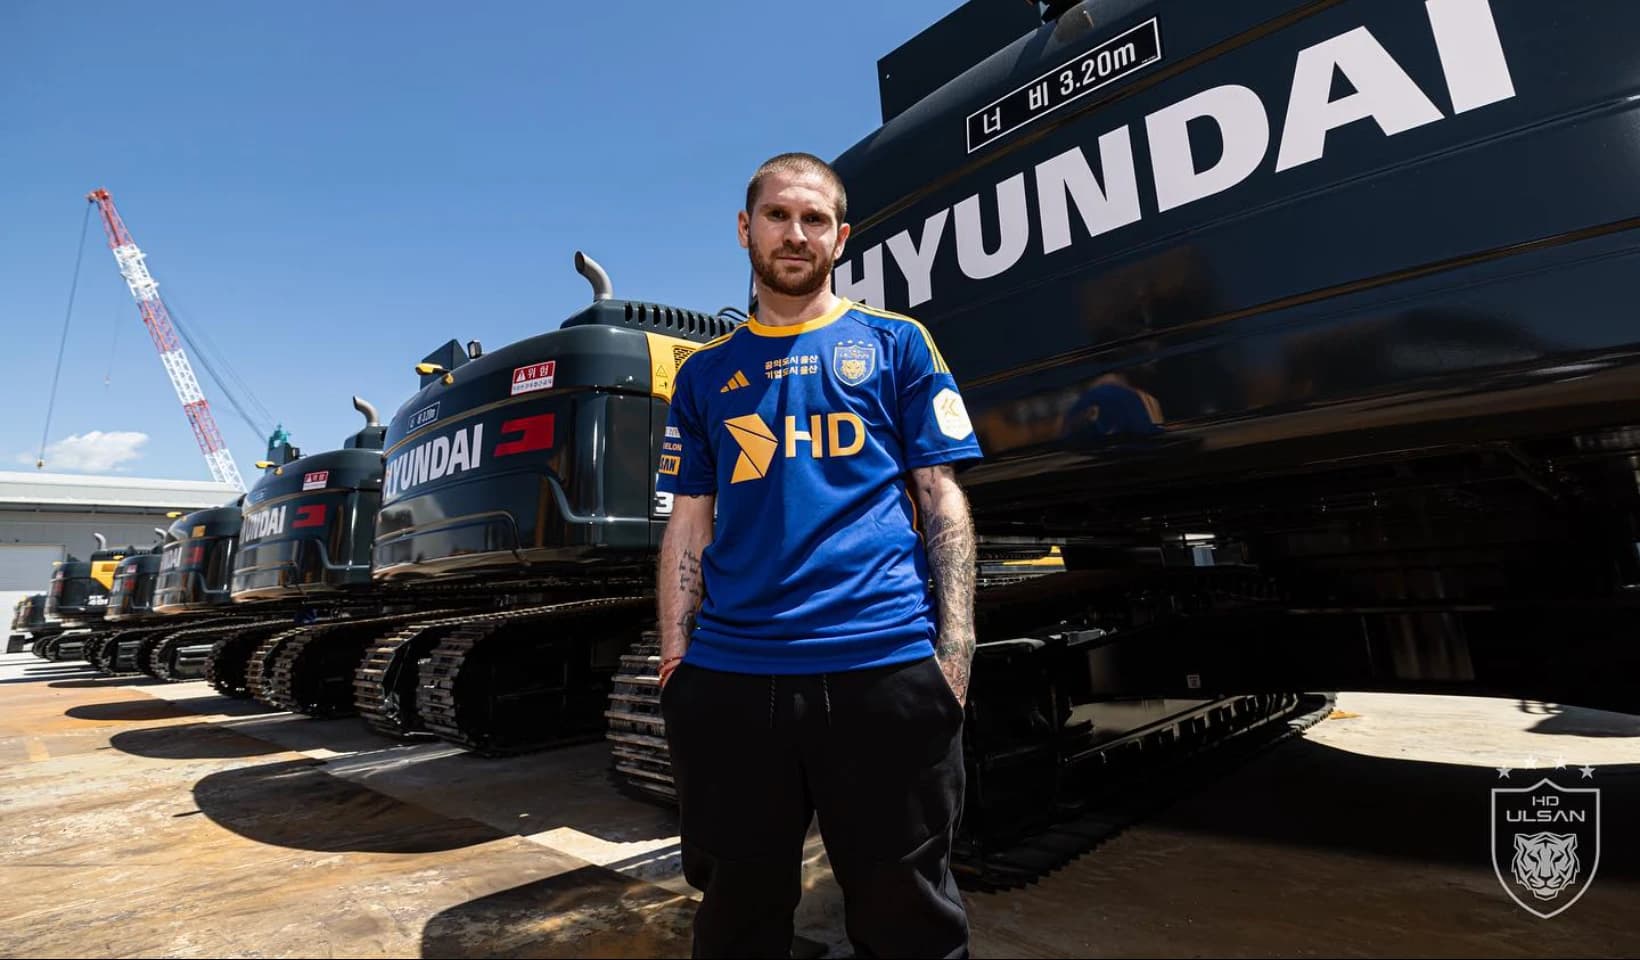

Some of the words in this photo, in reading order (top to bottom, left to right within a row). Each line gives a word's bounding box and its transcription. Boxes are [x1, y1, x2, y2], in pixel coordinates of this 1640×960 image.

[983, 107, 1001, 134] 너
[1028, 81, 1049, 110] 비
[1059, 43, 1136, 96] 3.20m
[834, 0, 1516, 311] HYUNDAI
[784, 412, 866, 458] HD
